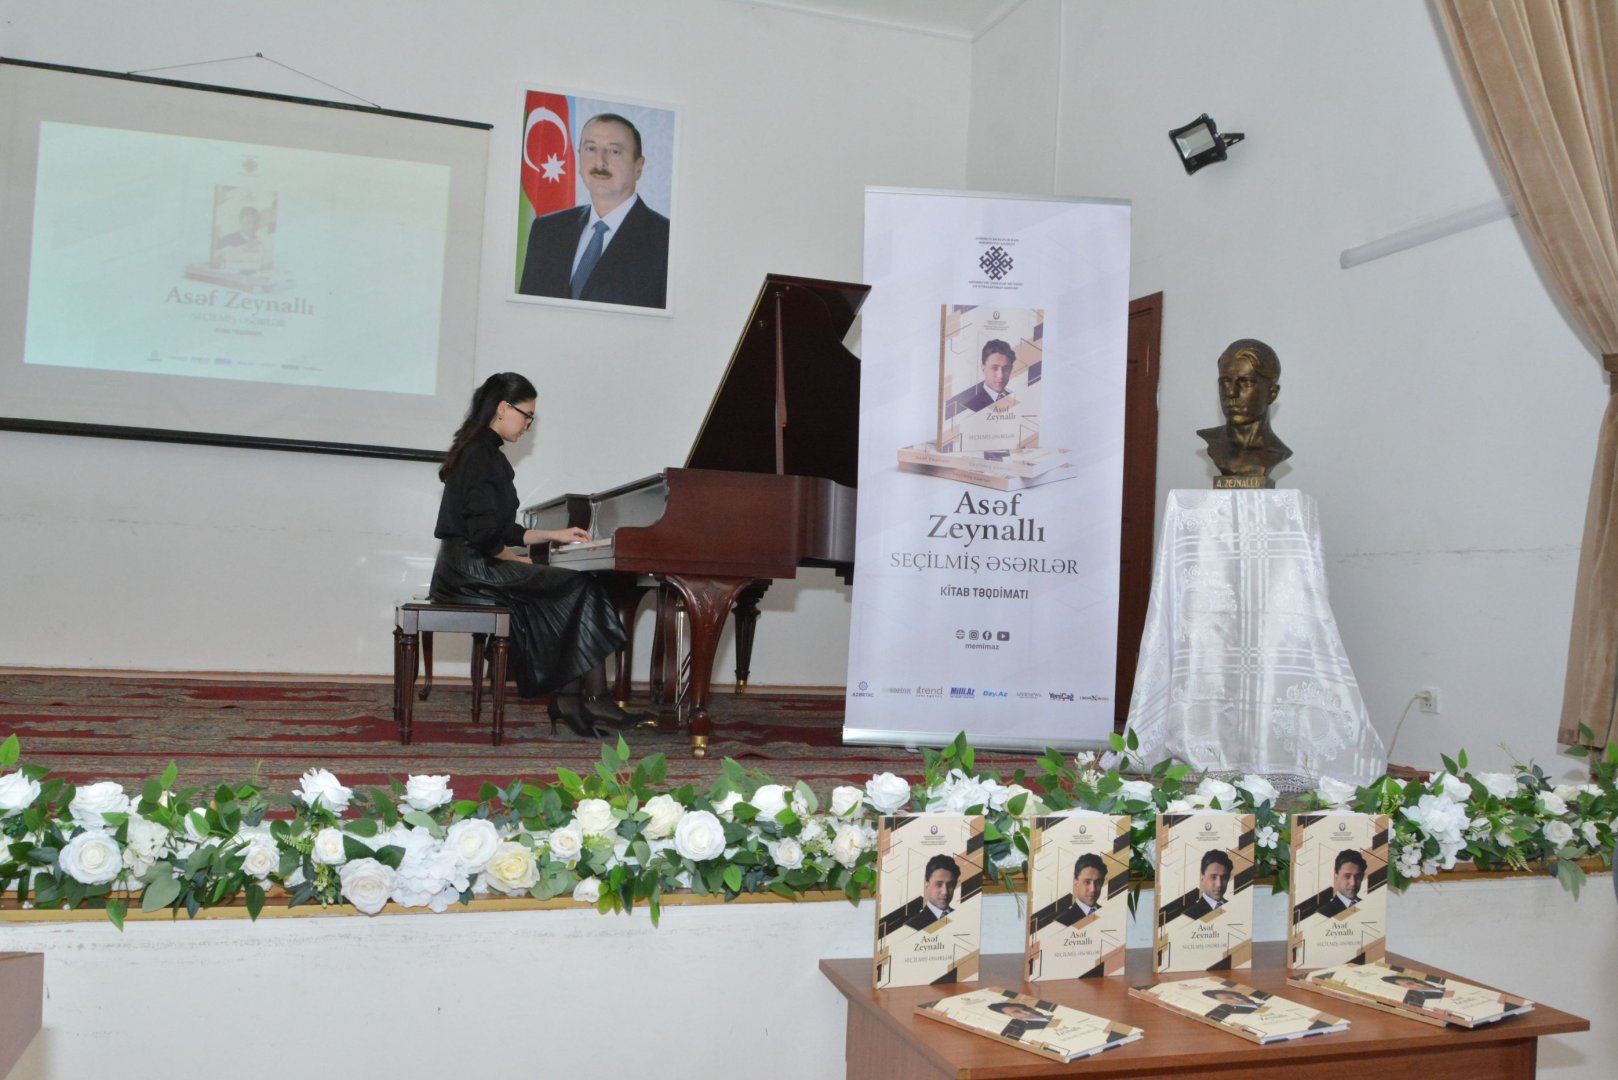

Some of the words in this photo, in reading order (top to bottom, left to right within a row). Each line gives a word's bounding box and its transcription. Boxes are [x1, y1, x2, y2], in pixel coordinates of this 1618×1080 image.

[165, 286, 219, 307] Asəf
[224, 290, 314, 316] Zeynallı
[953, 491, 1022, 516] Asəf
[927, 514, 1047, 548] Zeynallı
[890, 550, 980, 574] SEÇİLMİŞ
[986, 555, 1079, 574] ƏSƏRLƏR
[940, 584, 970, 597] KİTAB
[973, 586, 1029, 600] TƏQDİMATI
